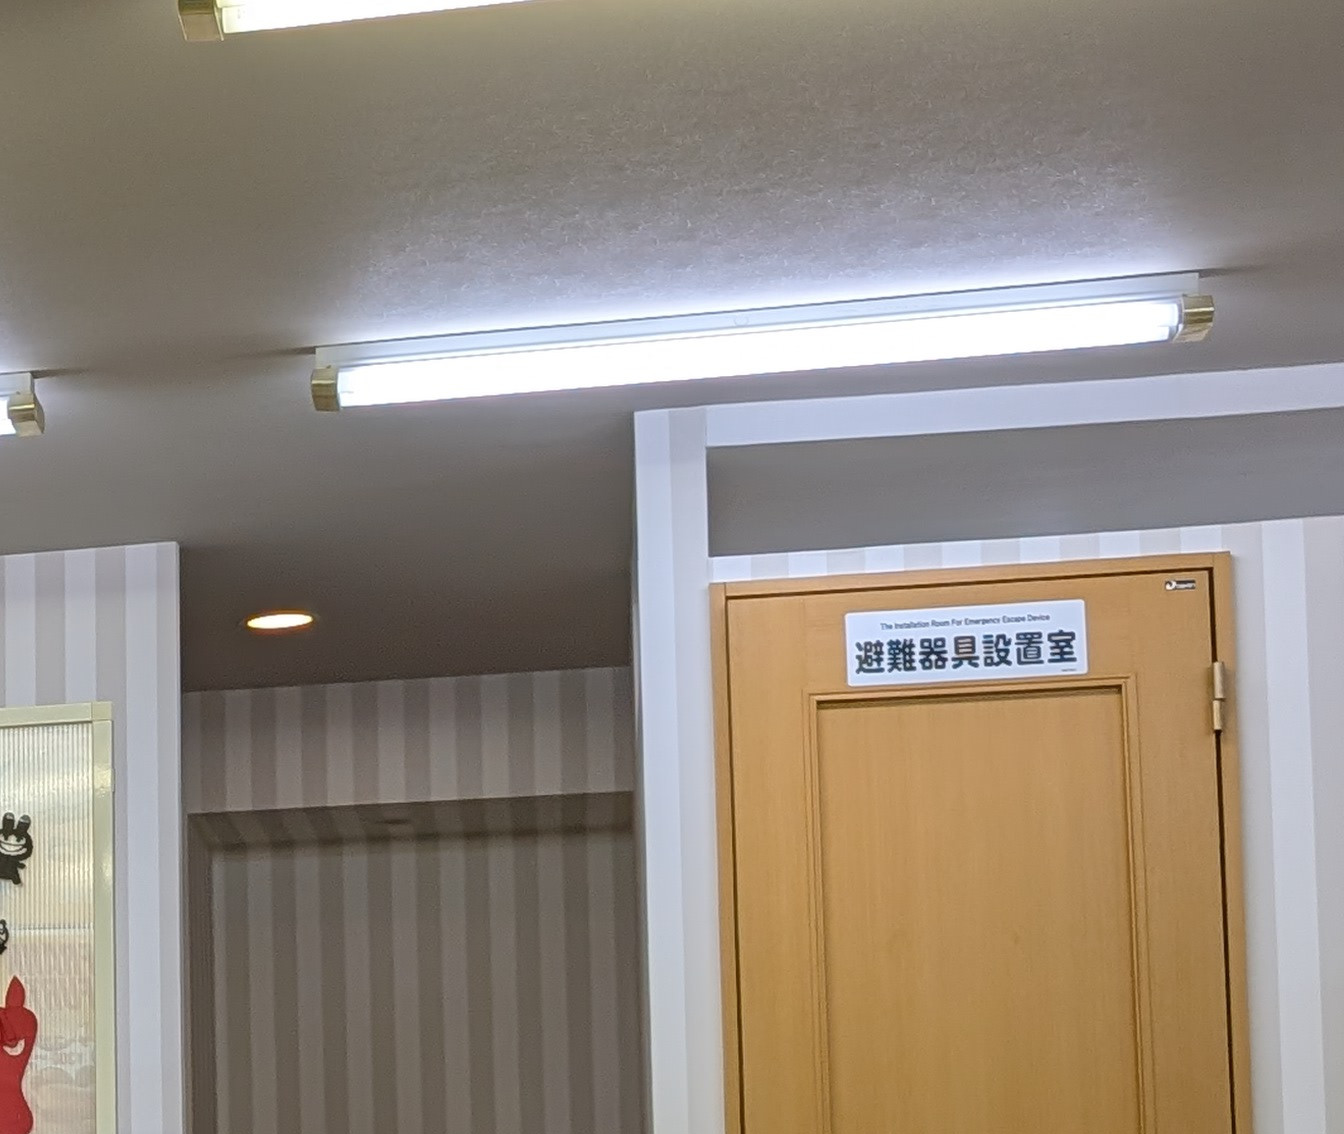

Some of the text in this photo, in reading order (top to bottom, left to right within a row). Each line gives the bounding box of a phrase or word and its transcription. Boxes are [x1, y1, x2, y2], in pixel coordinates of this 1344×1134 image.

[881, 613, 1050, 630] The Installation Room For Emergency Escape Device
[854, 630, 1078, 675] 避難器具設置室
